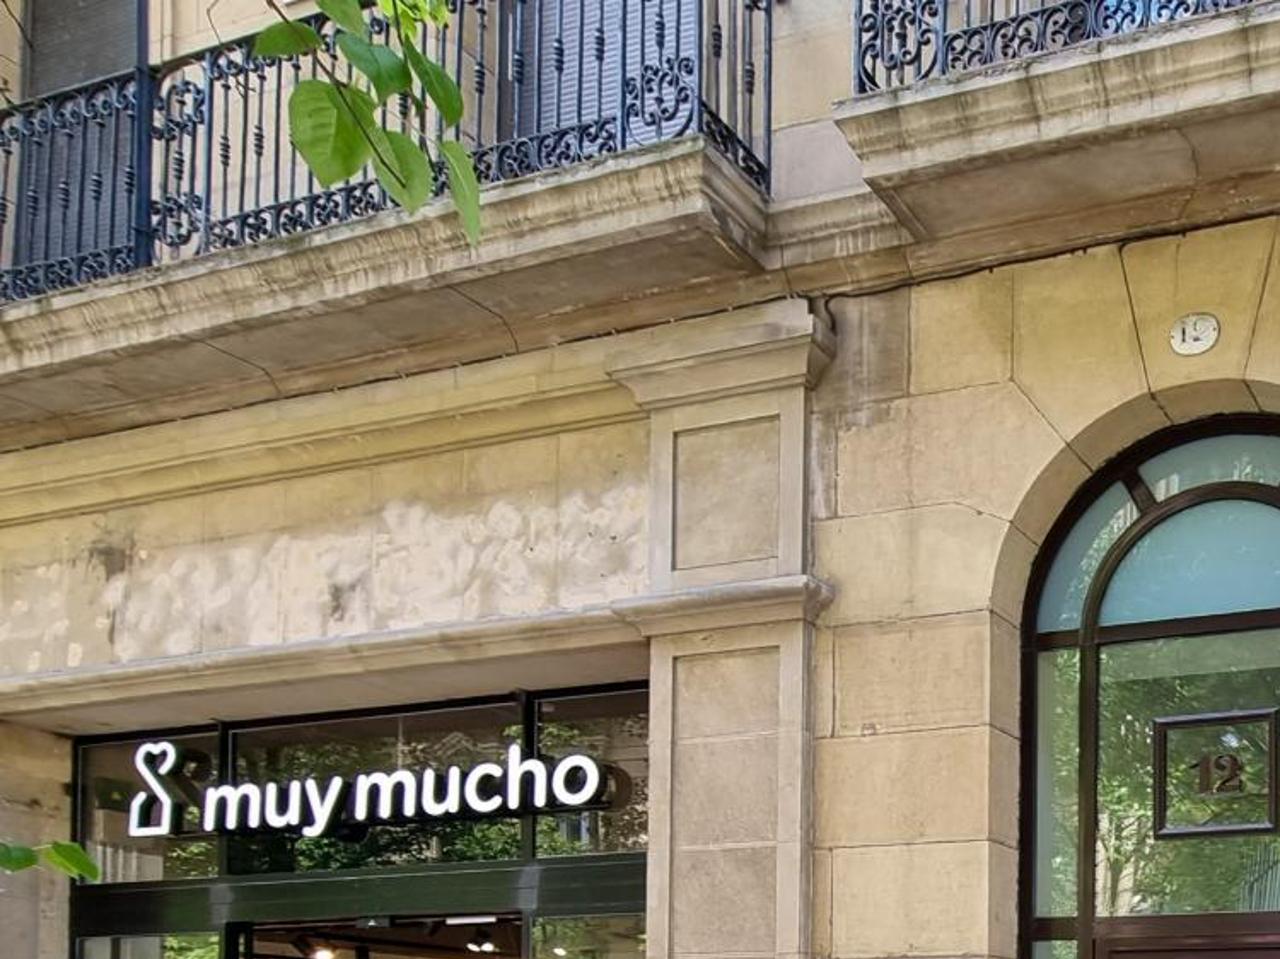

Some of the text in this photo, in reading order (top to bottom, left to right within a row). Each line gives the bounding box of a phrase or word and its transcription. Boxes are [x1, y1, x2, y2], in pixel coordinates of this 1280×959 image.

[202, 743, 600, 839] muy mucho
[1189, 753, 1244, 795] 12
